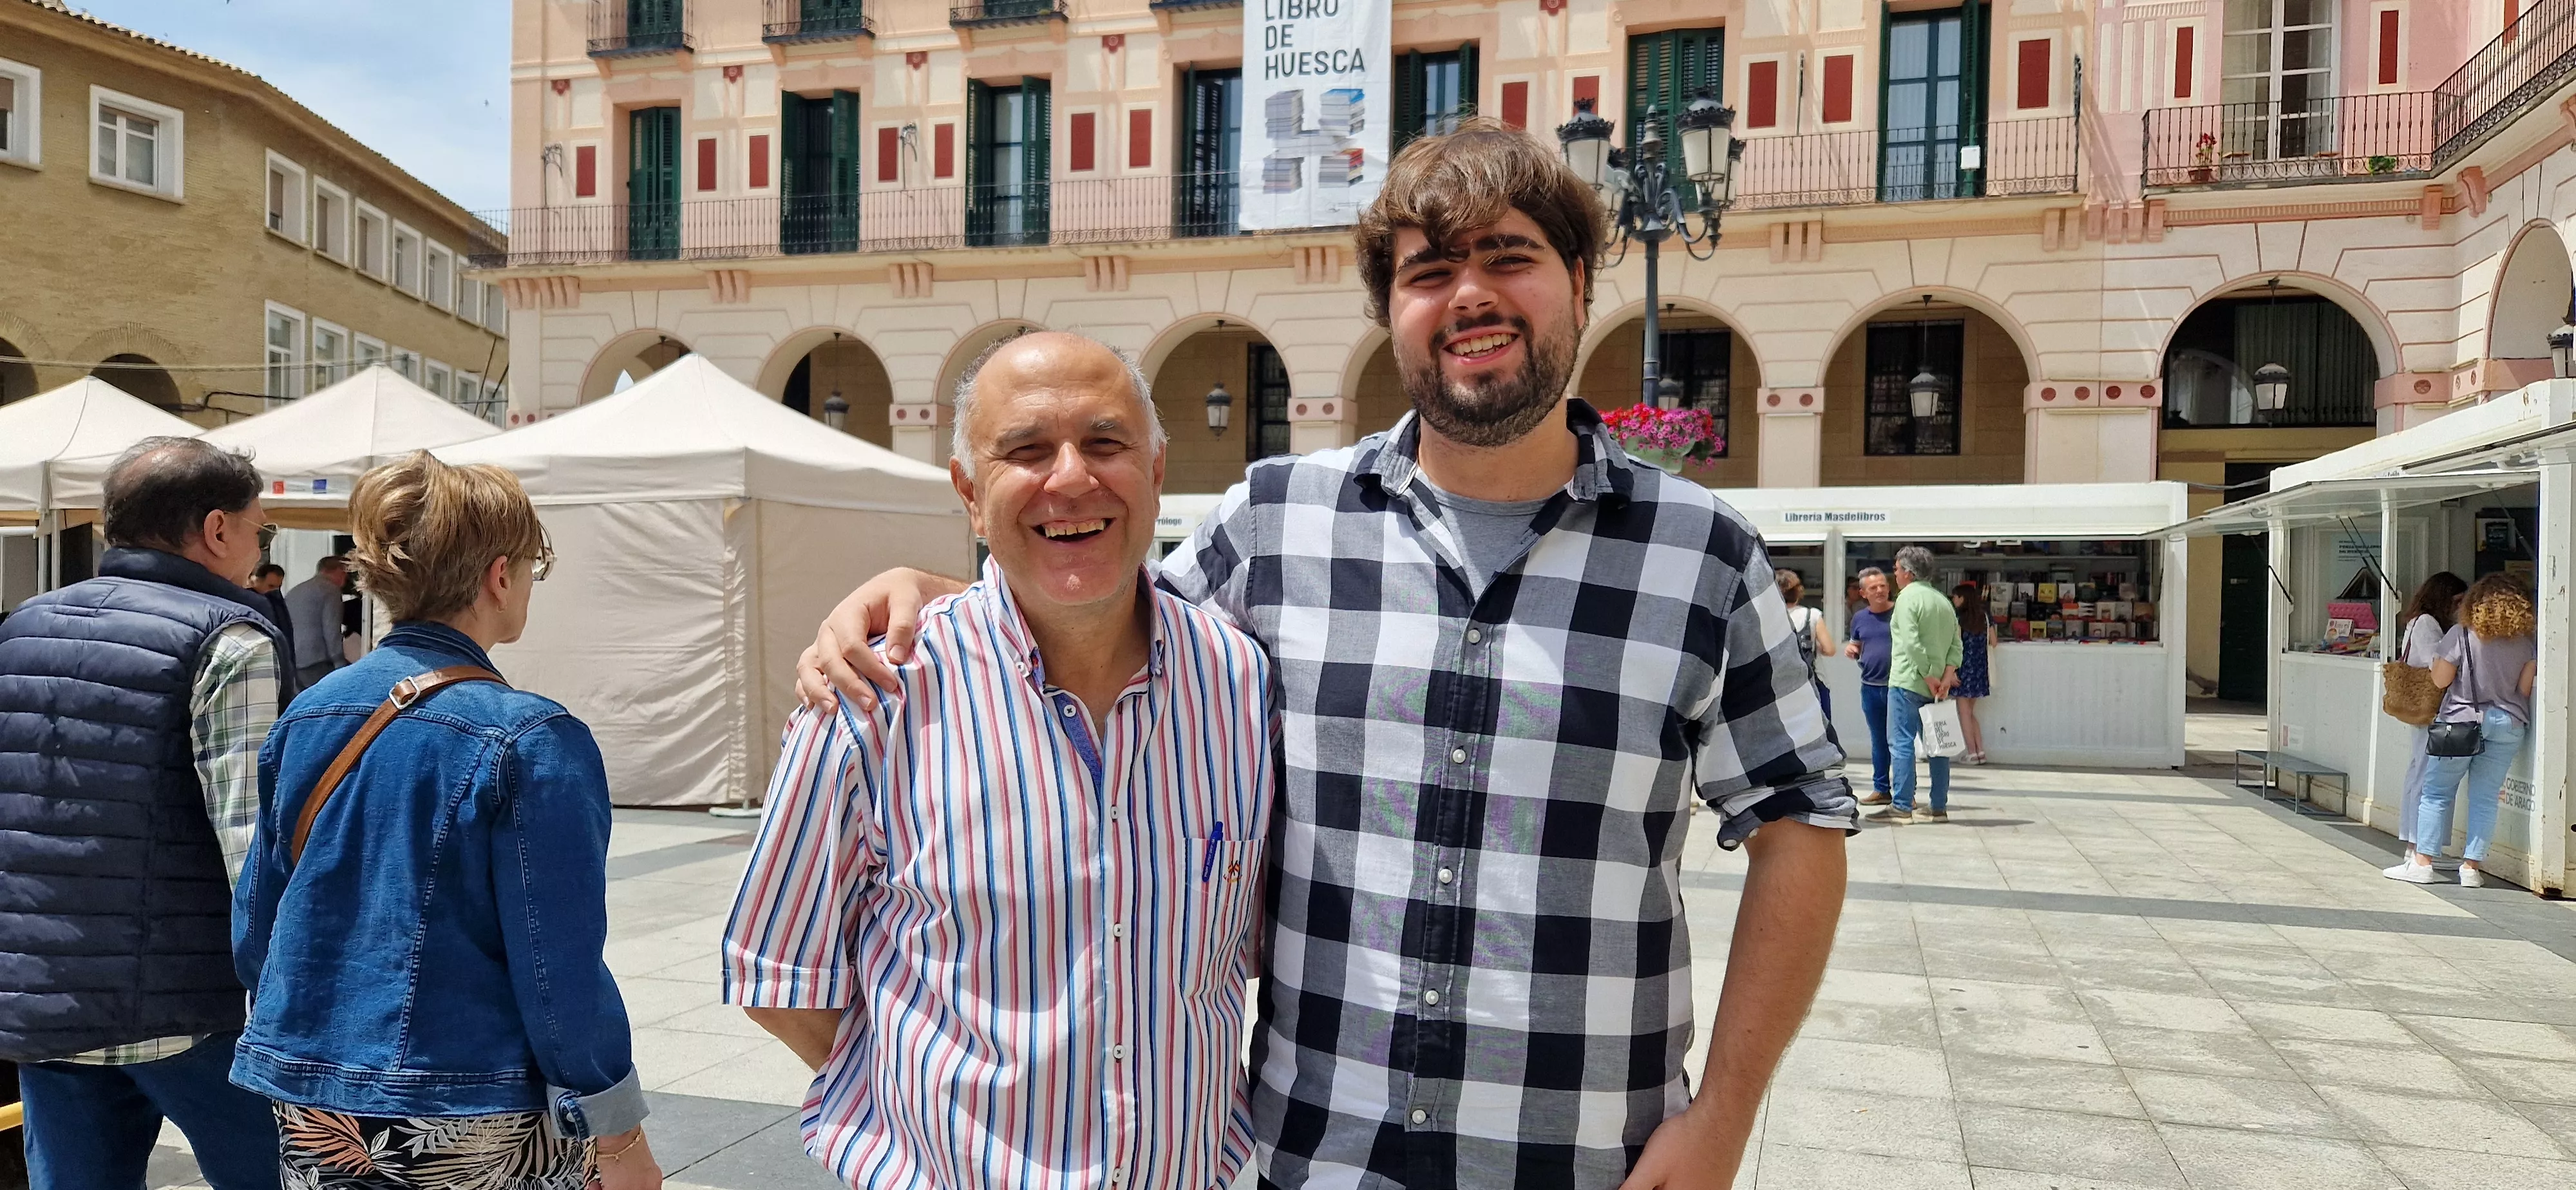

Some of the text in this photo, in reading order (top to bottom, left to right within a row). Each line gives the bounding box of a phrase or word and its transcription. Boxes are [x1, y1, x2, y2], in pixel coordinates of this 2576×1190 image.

[1265, 0, 1338, 21] LIBRO
[1265, 24, 1294, 51] DE
[1265, 48, 1365, 80] HUESCA
[1824, 512, 1886, 522] Masdelibros
[2506, 777, 2536, 797] GOBIERNO
[2506, 792, 2514, 807] DE
